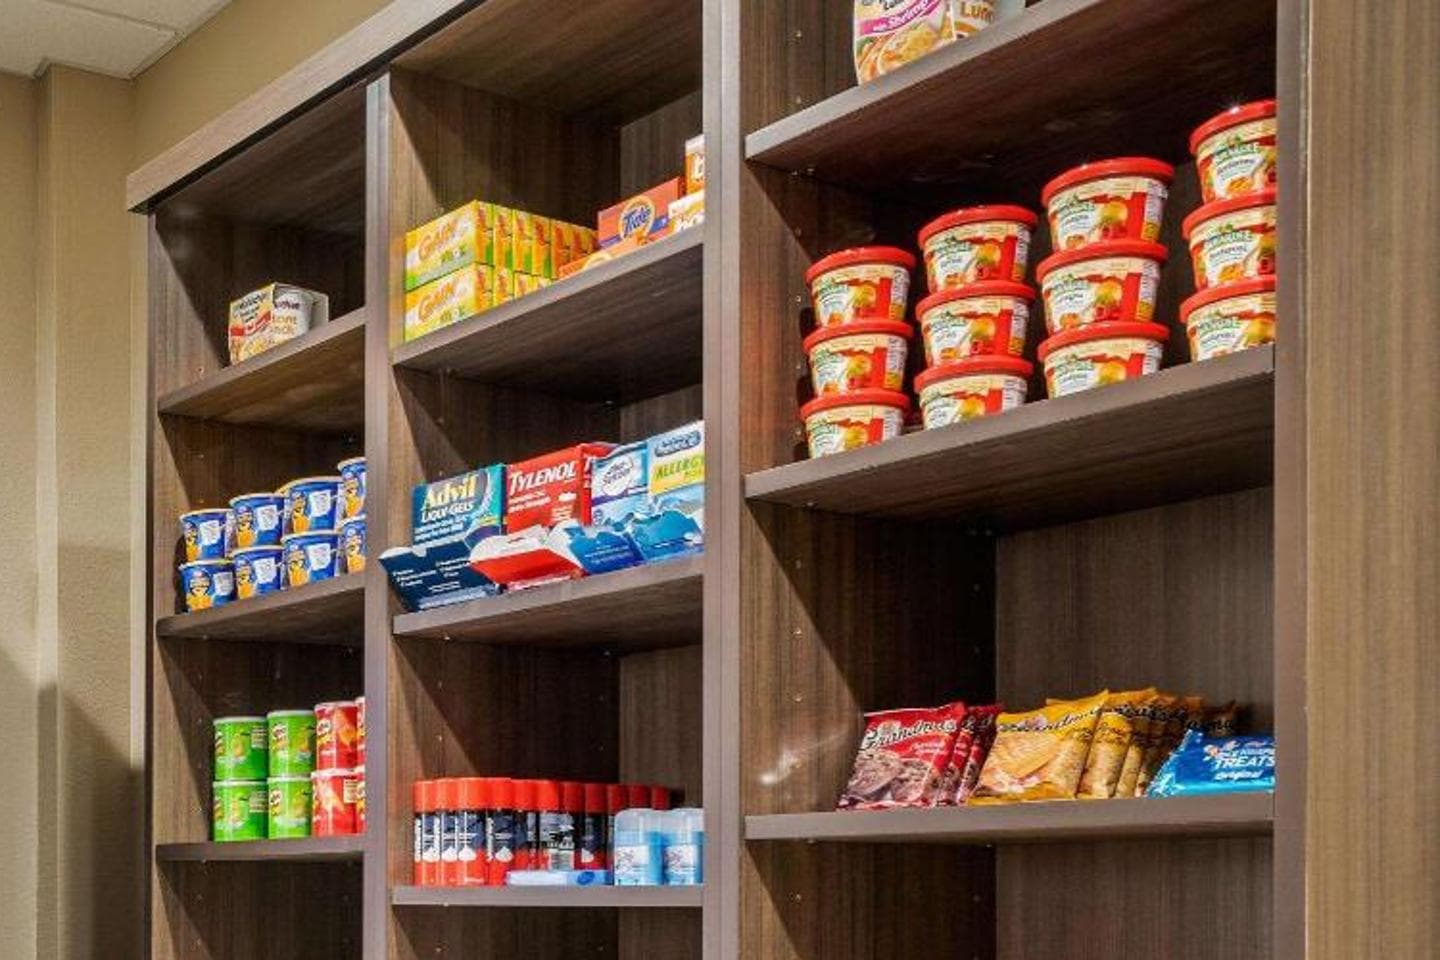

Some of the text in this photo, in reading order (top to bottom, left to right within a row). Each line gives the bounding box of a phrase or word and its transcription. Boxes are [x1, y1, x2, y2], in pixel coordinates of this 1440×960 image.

[421, 473, 477, 511] Advil
[509, 461, 576, 496] TYLENOL
[1213, 755, 1275, 769] TREATS
